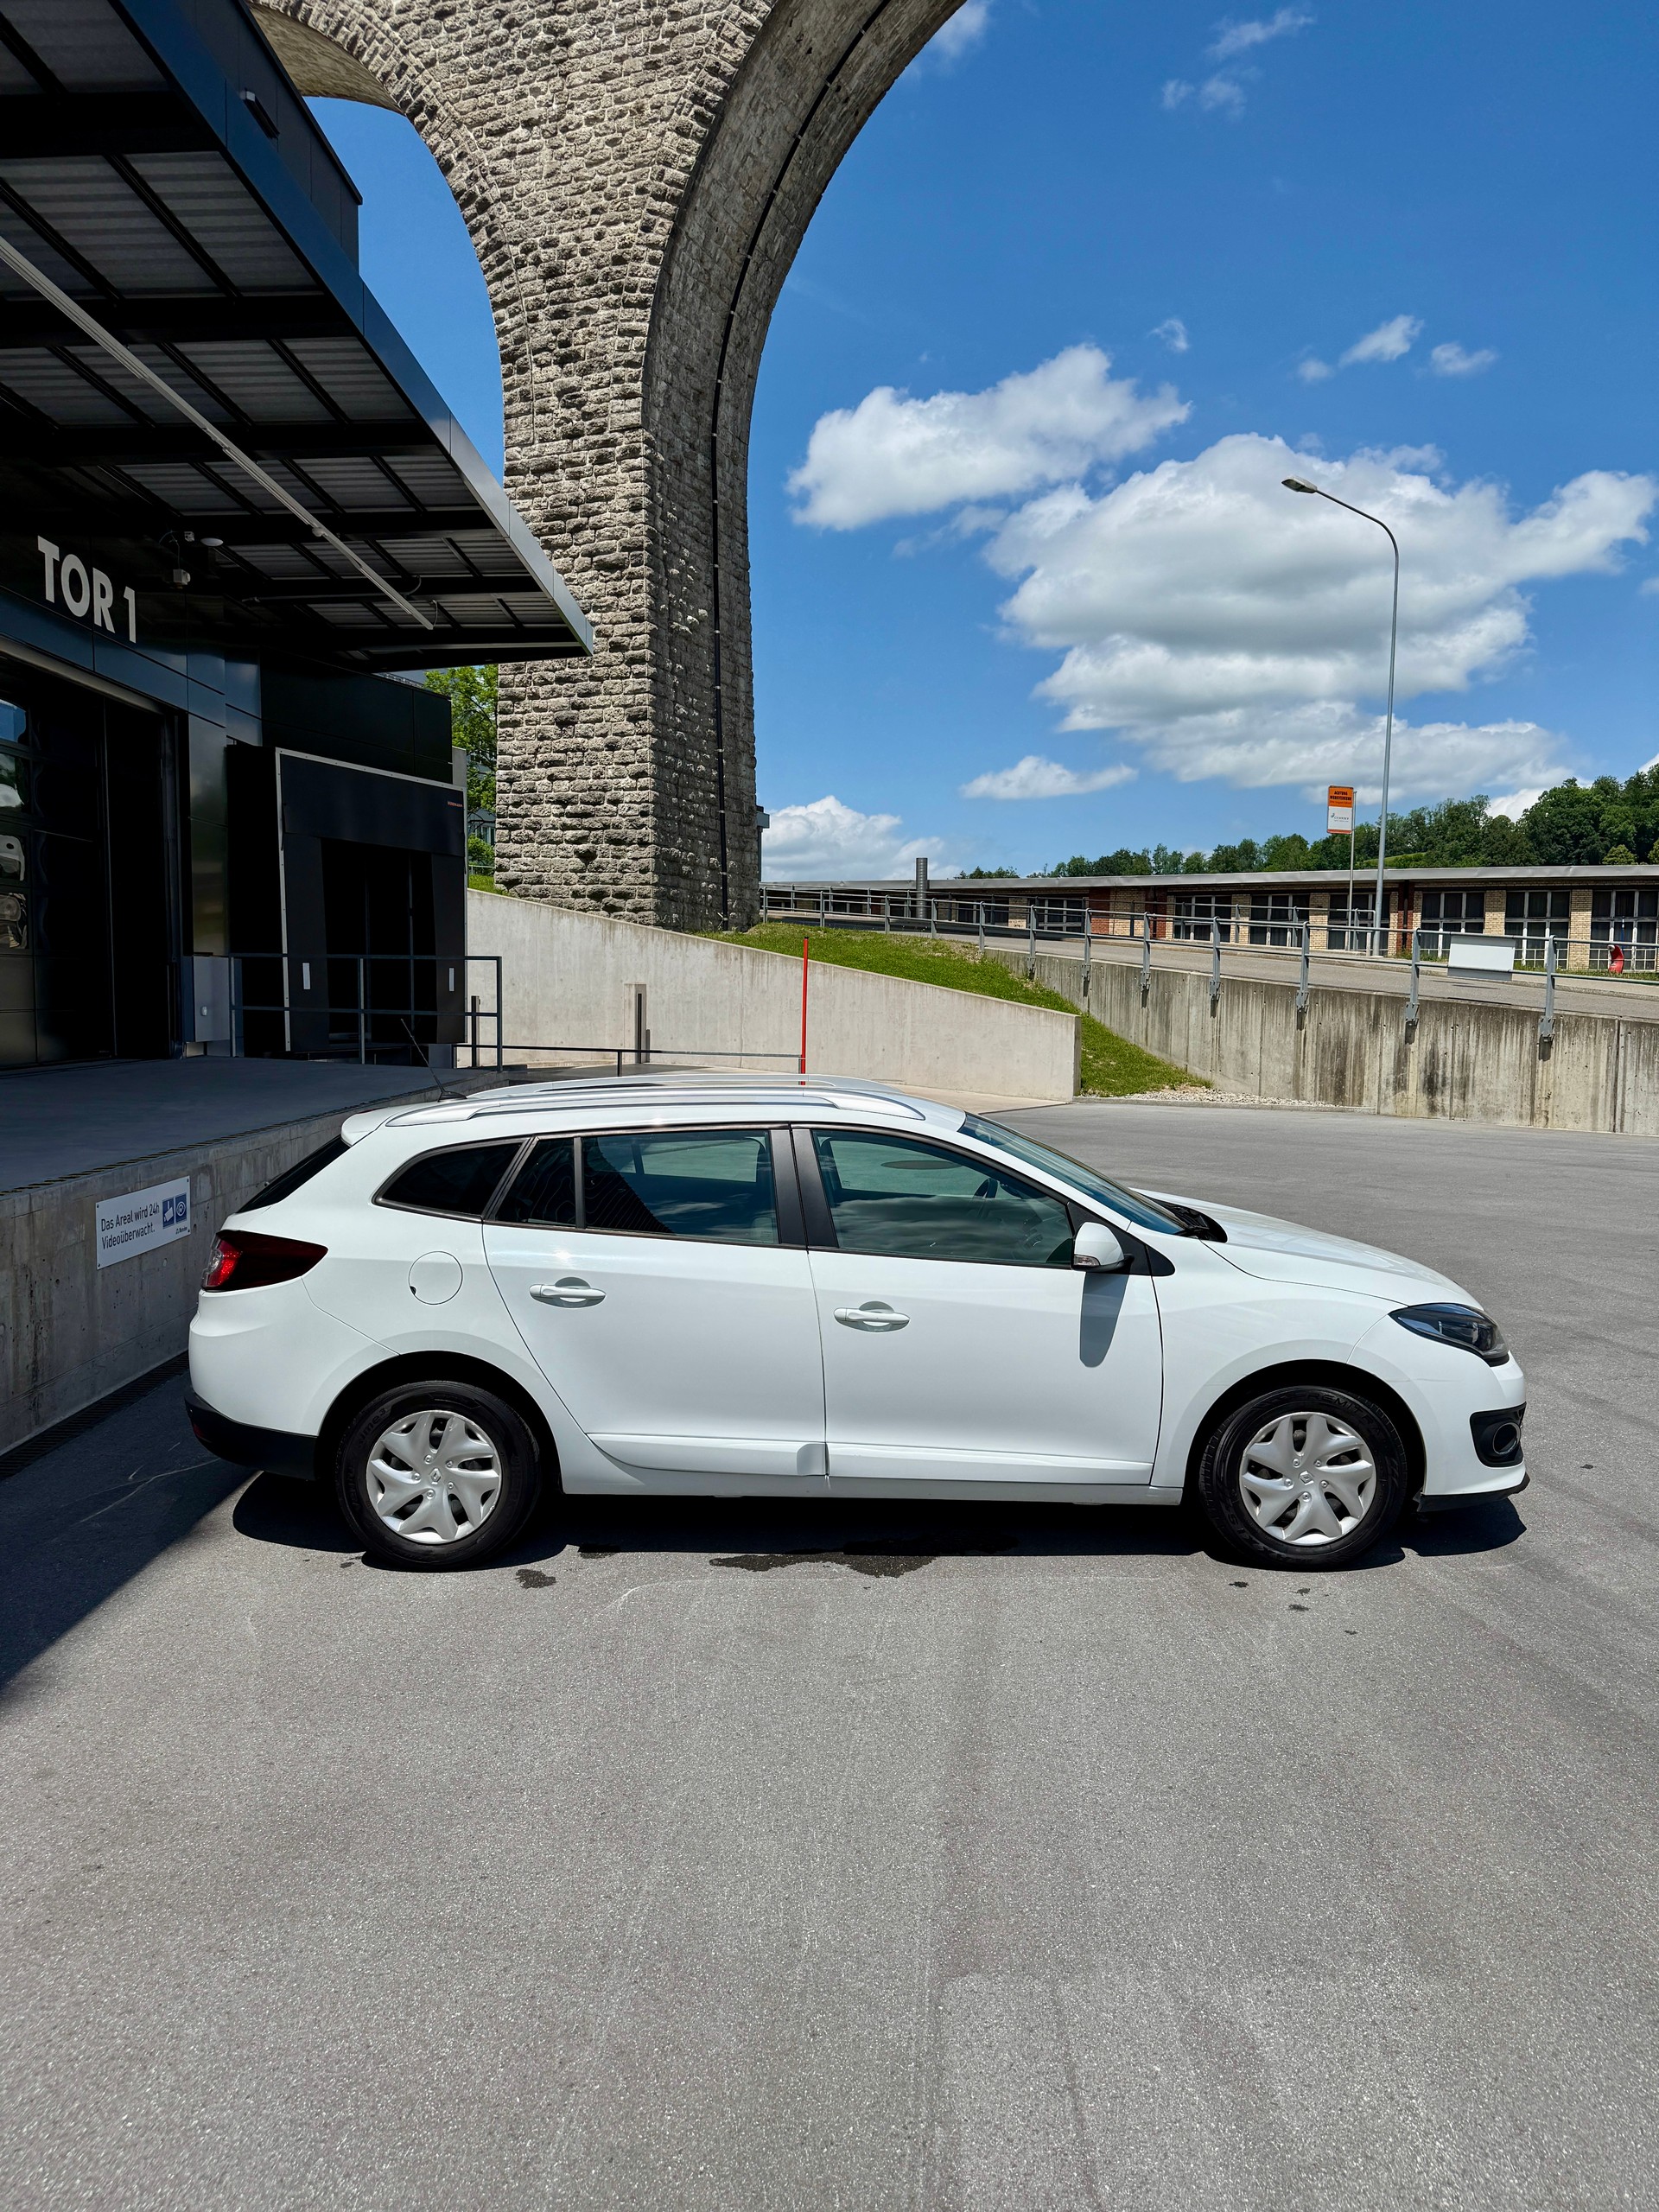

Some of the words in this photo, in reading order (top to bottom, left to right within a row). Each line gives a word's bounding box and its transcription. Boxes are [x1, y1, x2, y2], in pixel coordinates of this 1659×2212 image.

[37, 535, 116, 633] TOR
[123, 586, 137, 644] 1
[100, 1218, 114, 1231] Das
[115, 1210, 133, 1227] Areal
[134, 1205, 148, 1221] wird
[149, 1202, 160, 1217] 24h
[101, 1222, 156, 1249] Videoüberwacht.
